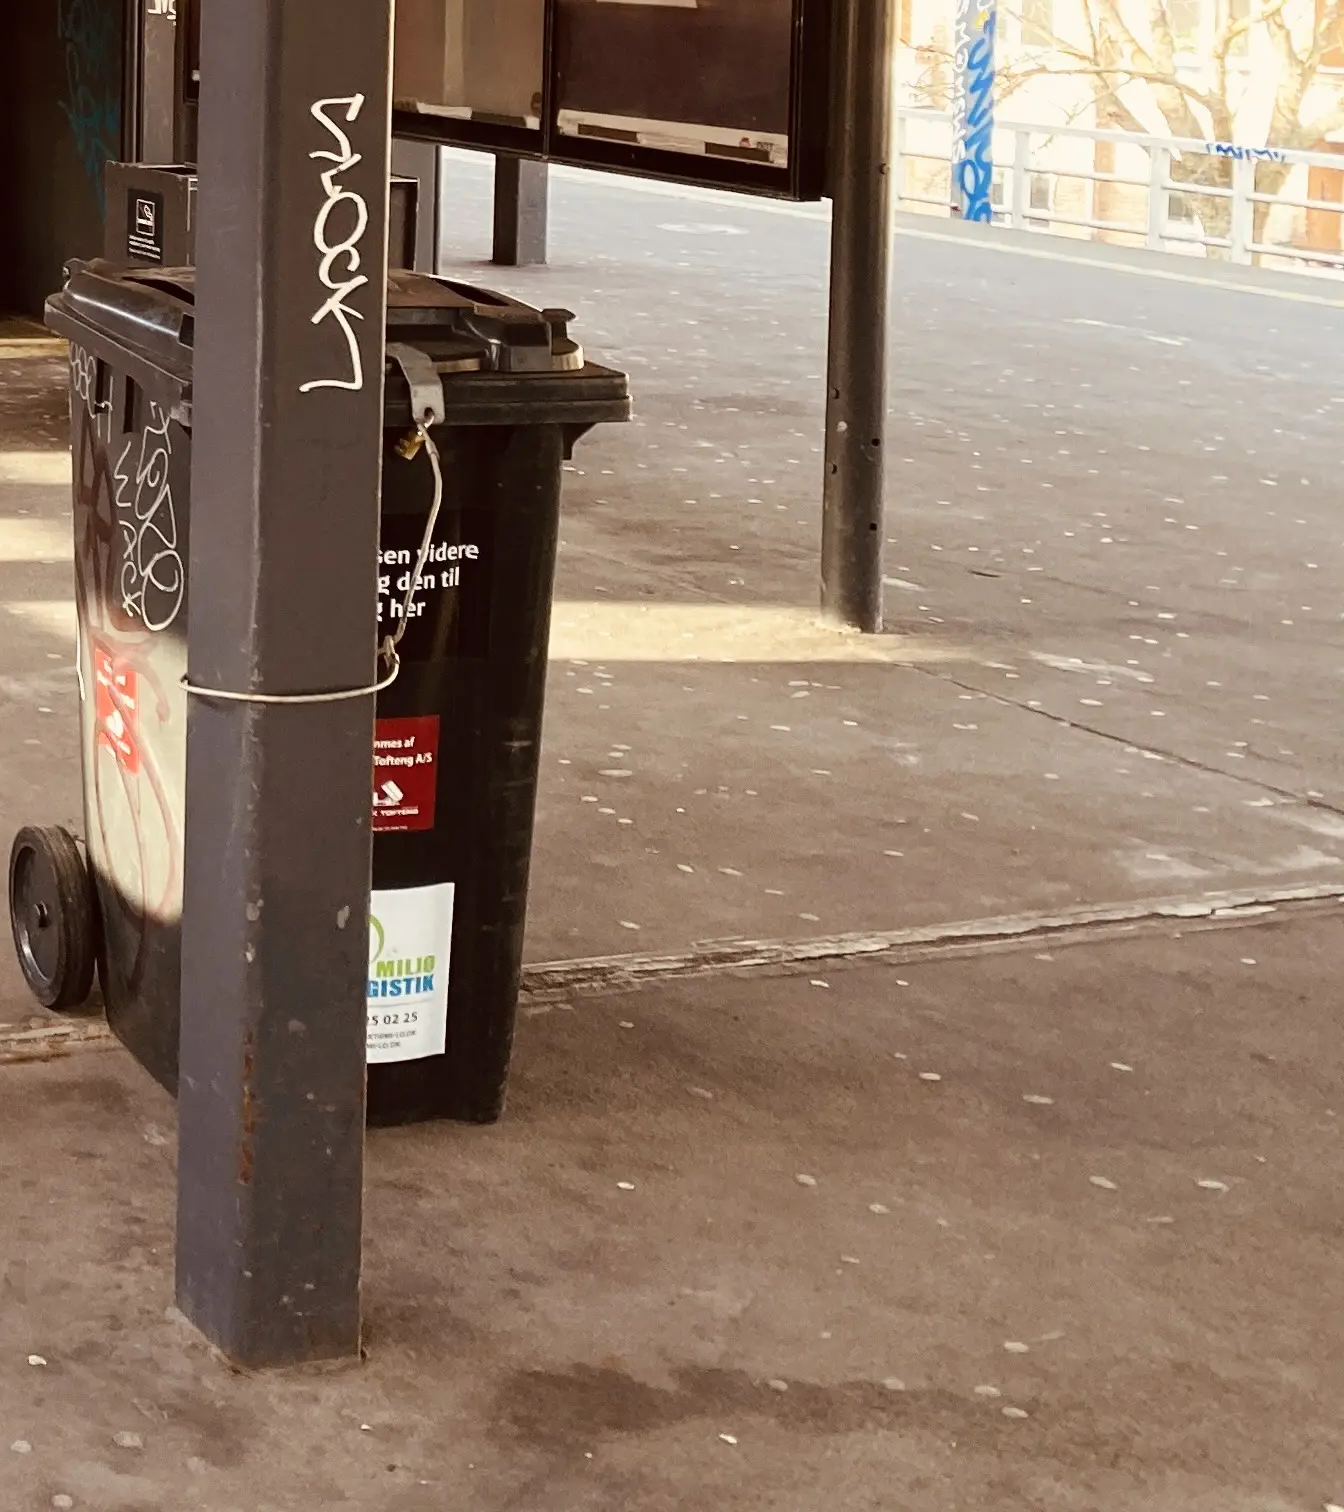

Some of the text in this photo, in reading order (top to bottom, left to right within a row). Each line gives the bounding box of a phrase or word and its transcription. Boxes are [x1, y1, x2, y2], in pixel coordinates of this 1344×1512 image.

[396, 571, 436, 591] den
[440, 566, 460, 588] til
[390, 598, 427, 618] her
[404, 736, 416, 748] af
[415, 752, 433, 764] A/S
[367, 1012, 418, 1026] 5 02 25
